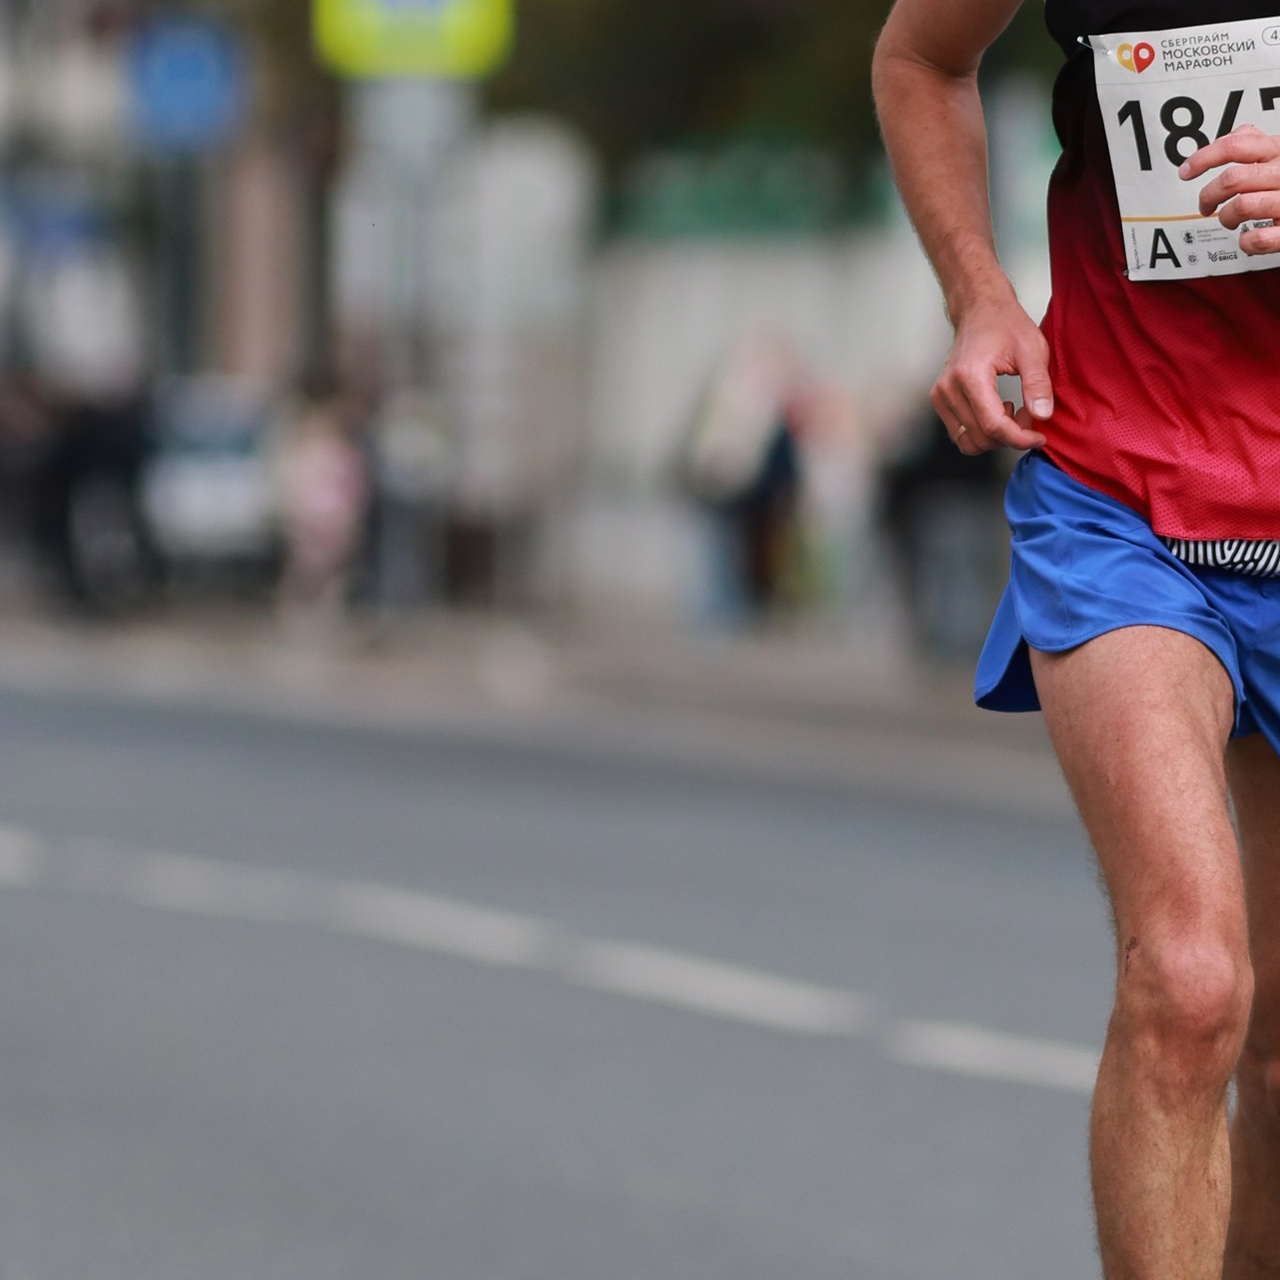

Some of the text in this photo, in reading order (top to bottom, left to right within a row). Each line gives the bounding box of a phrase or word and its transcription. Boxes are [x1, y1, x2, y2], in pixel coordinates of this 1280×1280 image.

[1160, 32, 1229, 48] СБЕРПРАЙМ
[1162, 38, 1255, 61] МОСКОВСКИЙ
[1164, 55, 1233, 72] МАРАФОН
[1149, 228, 1182, 269] A
[1218, 253, 1238, 262] BRICS
